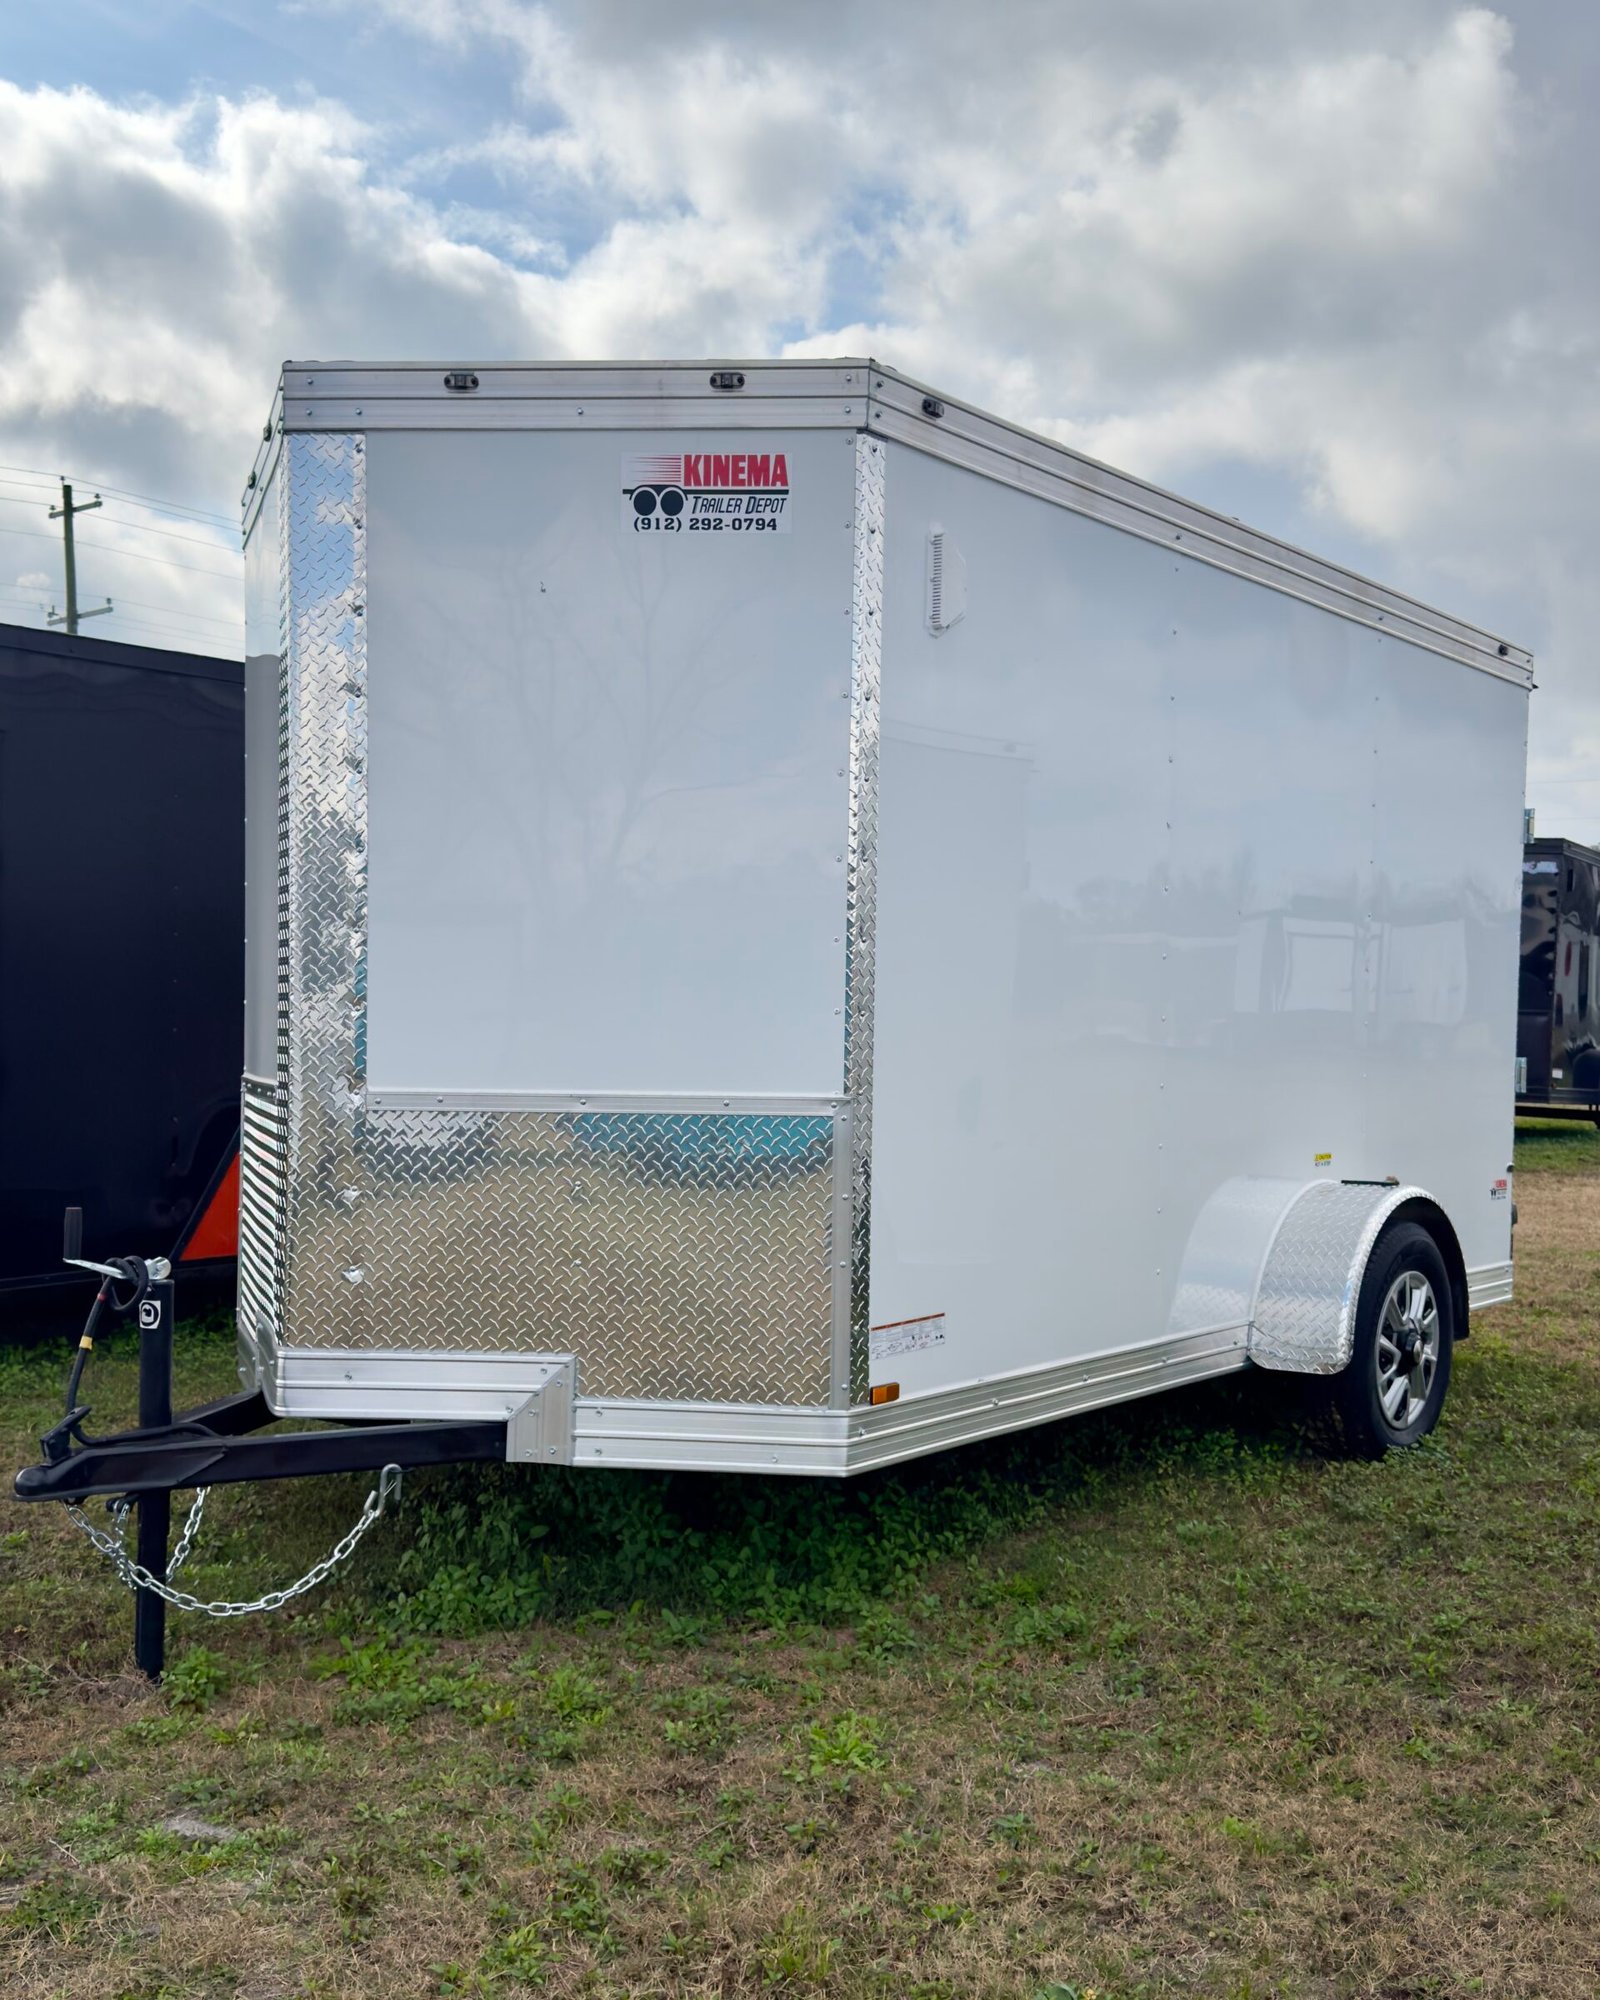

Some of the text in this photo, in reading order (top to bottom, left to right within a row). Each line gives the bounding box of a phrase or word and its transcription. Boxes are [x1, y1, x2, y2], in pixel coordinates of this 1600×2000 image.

[683, 454, 789, 487] KINEMA
[692, 495, 787, 514] TRAILER DEPOT
[633, 516, 777, 532] (912) 292-0794
